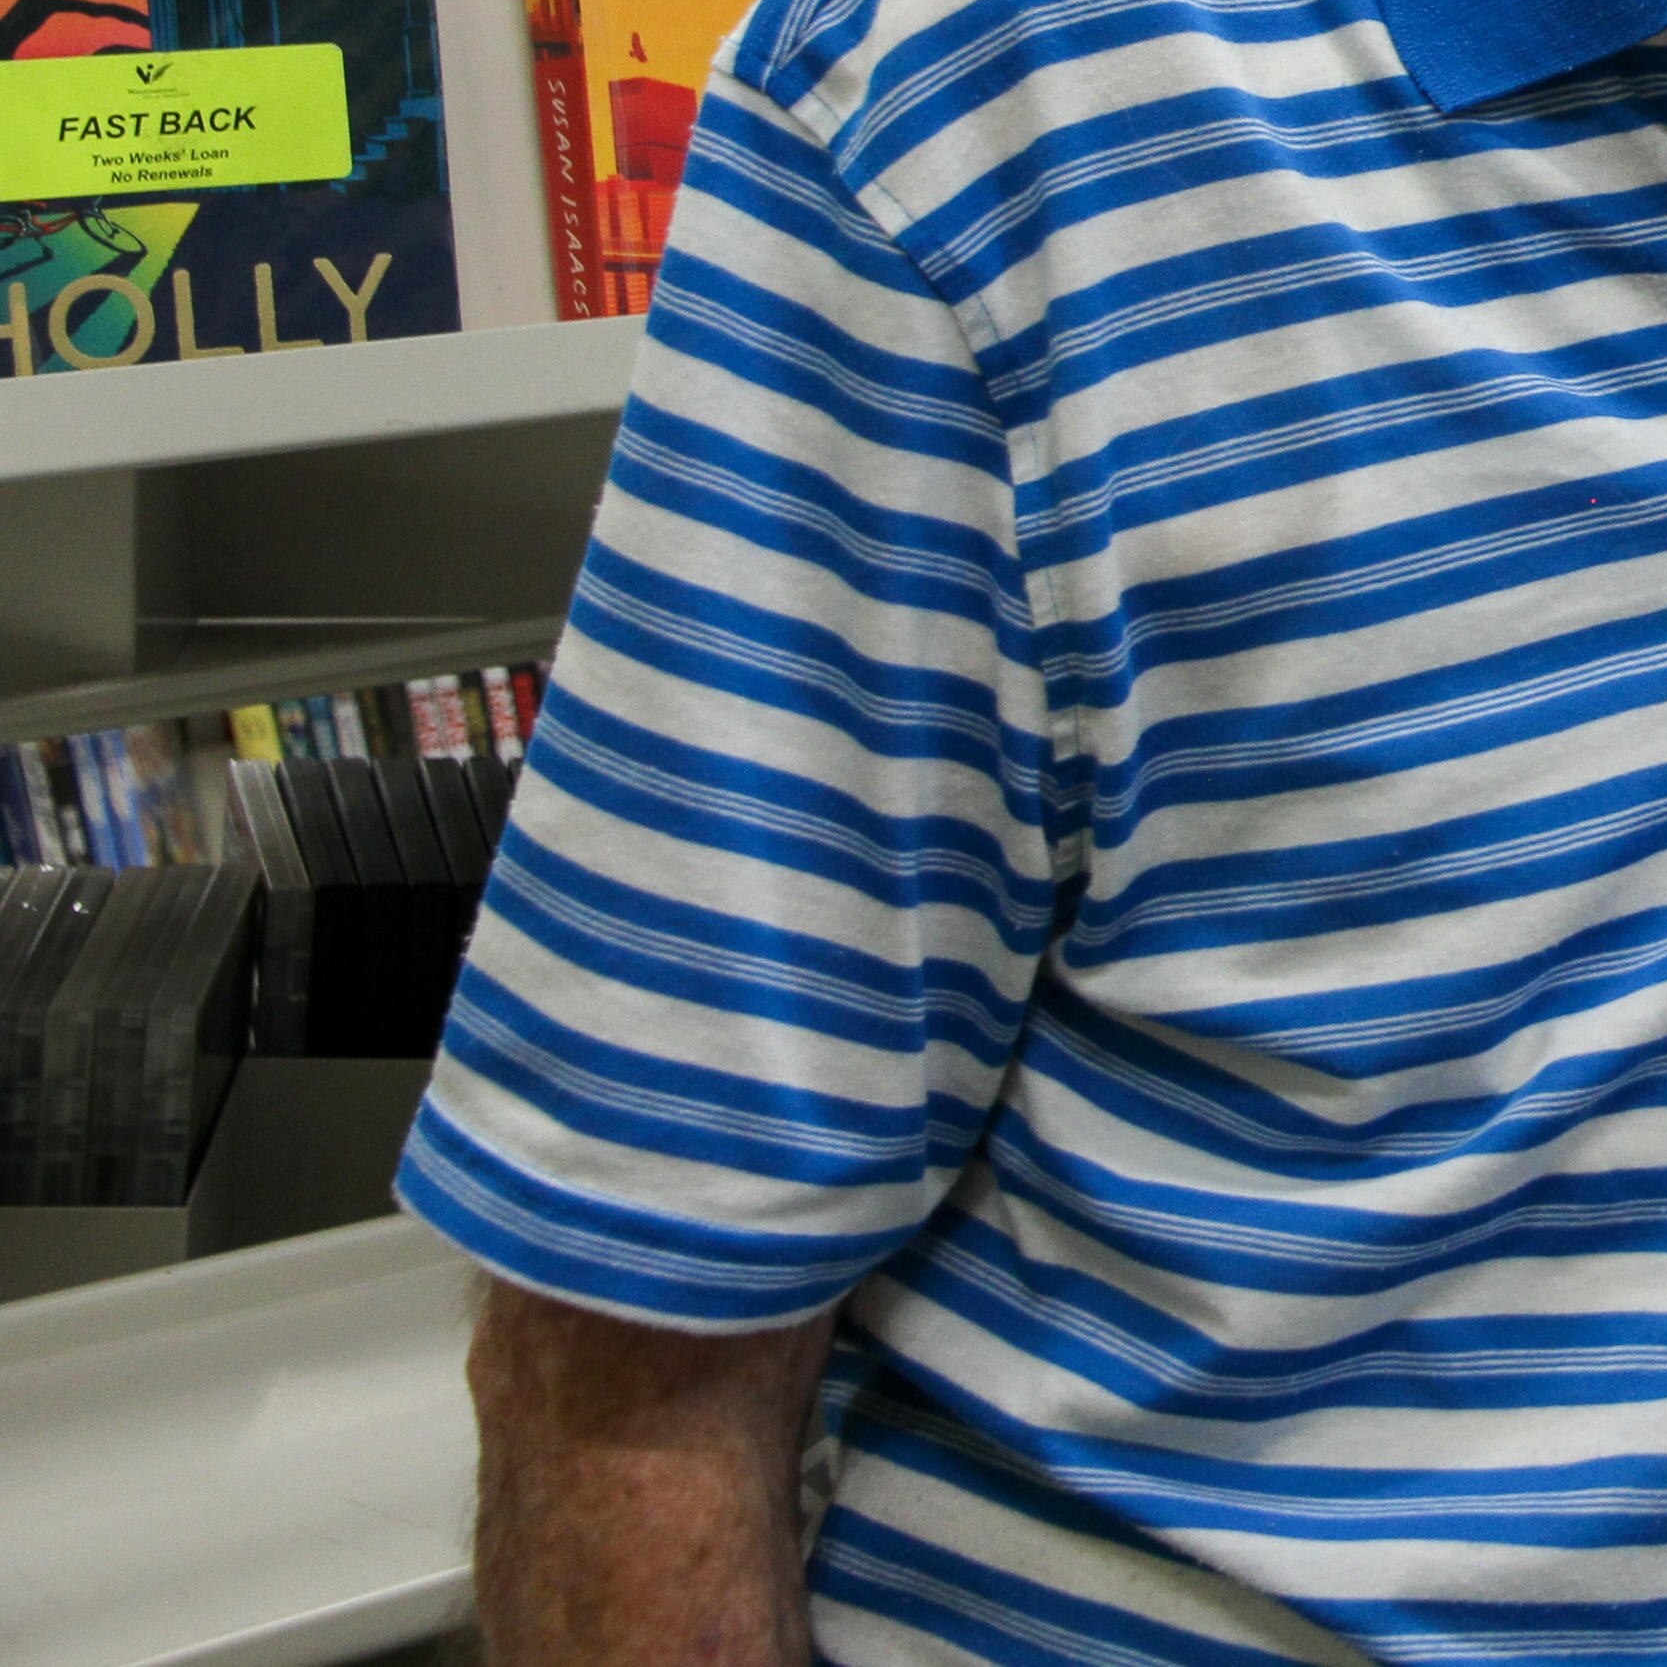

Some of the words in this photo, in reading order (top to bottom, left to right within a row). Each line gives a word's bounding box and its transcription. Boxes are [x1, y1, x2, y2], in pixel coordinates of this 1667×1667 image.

[58, 112, 149, 142] FAST
[160, 106, 257, 136] BACK
[547, 78, 575, 184] SUSAN
[92, 155, 124, 168] Two
[190, 147, 229, 161] Loan
[111, 170, 133, 184] No
[138, 166, 213, 182] Renewals
[560, 194, 592, 319] ISAACS
